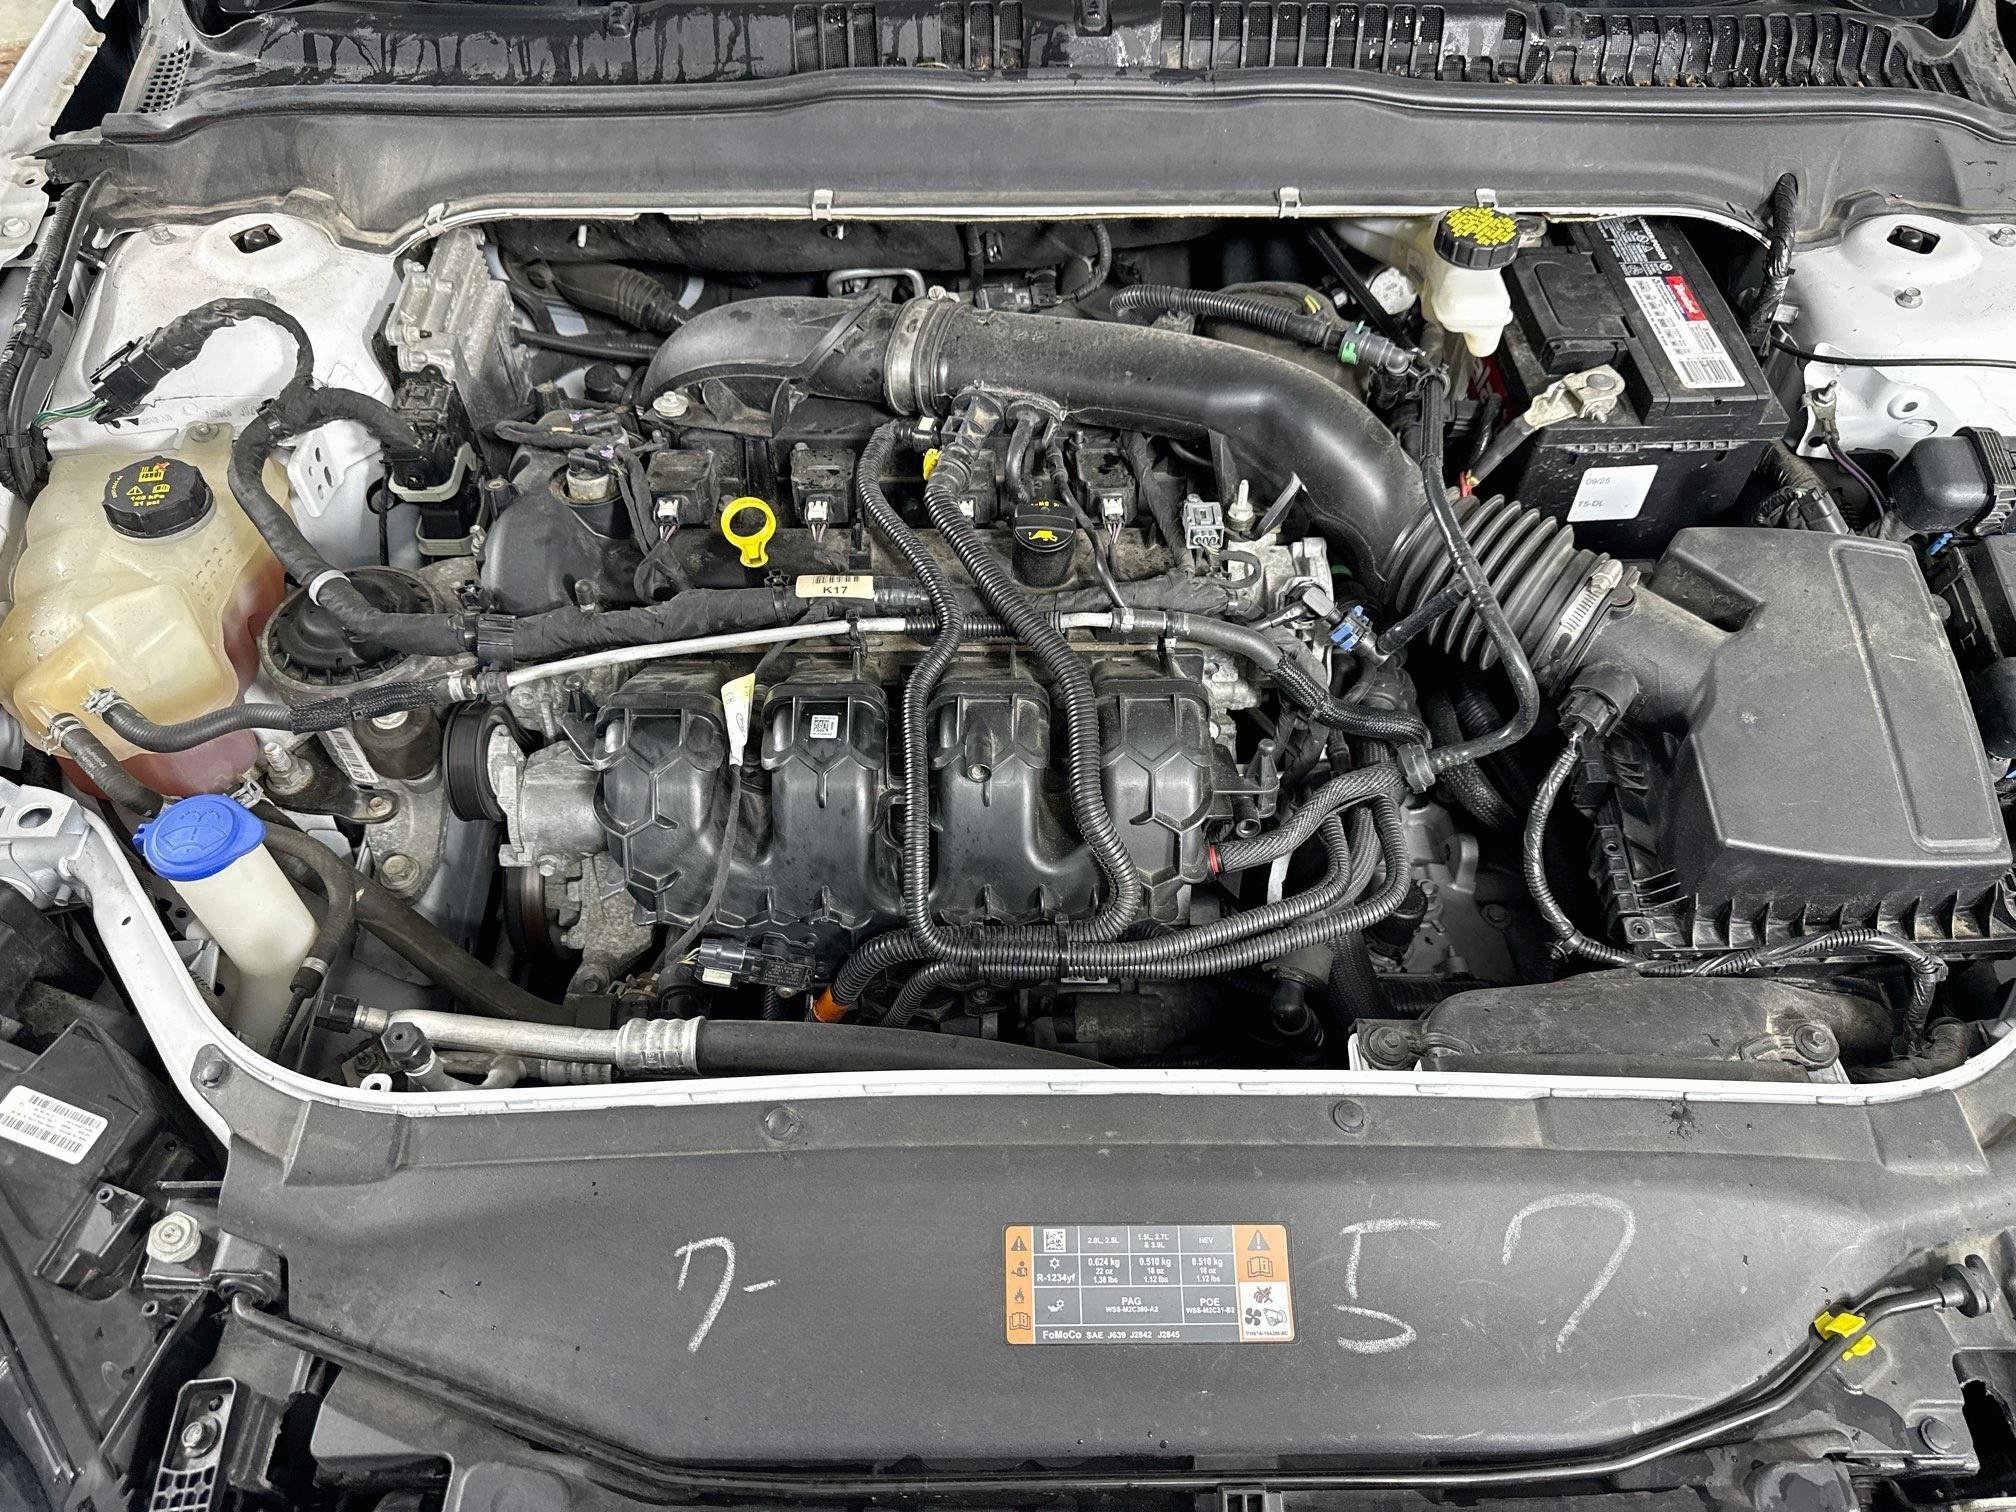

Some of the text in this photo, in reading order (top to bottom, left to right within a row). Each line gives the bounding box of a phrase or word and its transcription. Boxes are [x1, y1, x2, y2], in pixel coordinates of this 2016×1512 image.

[1088, 1258, 1120, 1268] 0.624 kg
[1139, 1257, 1171, 1267] 0.510 kg
[1192, 1257, 1223, 1267] 0.510 kg
[1036, 1273, 1076, 1283] R-1234yf
[1121, 1297, 1142, 1305] PAG
[1200, 1298, 1220, 1306] POE
[1042, 1331, 1082, 1340] FoMoCo
